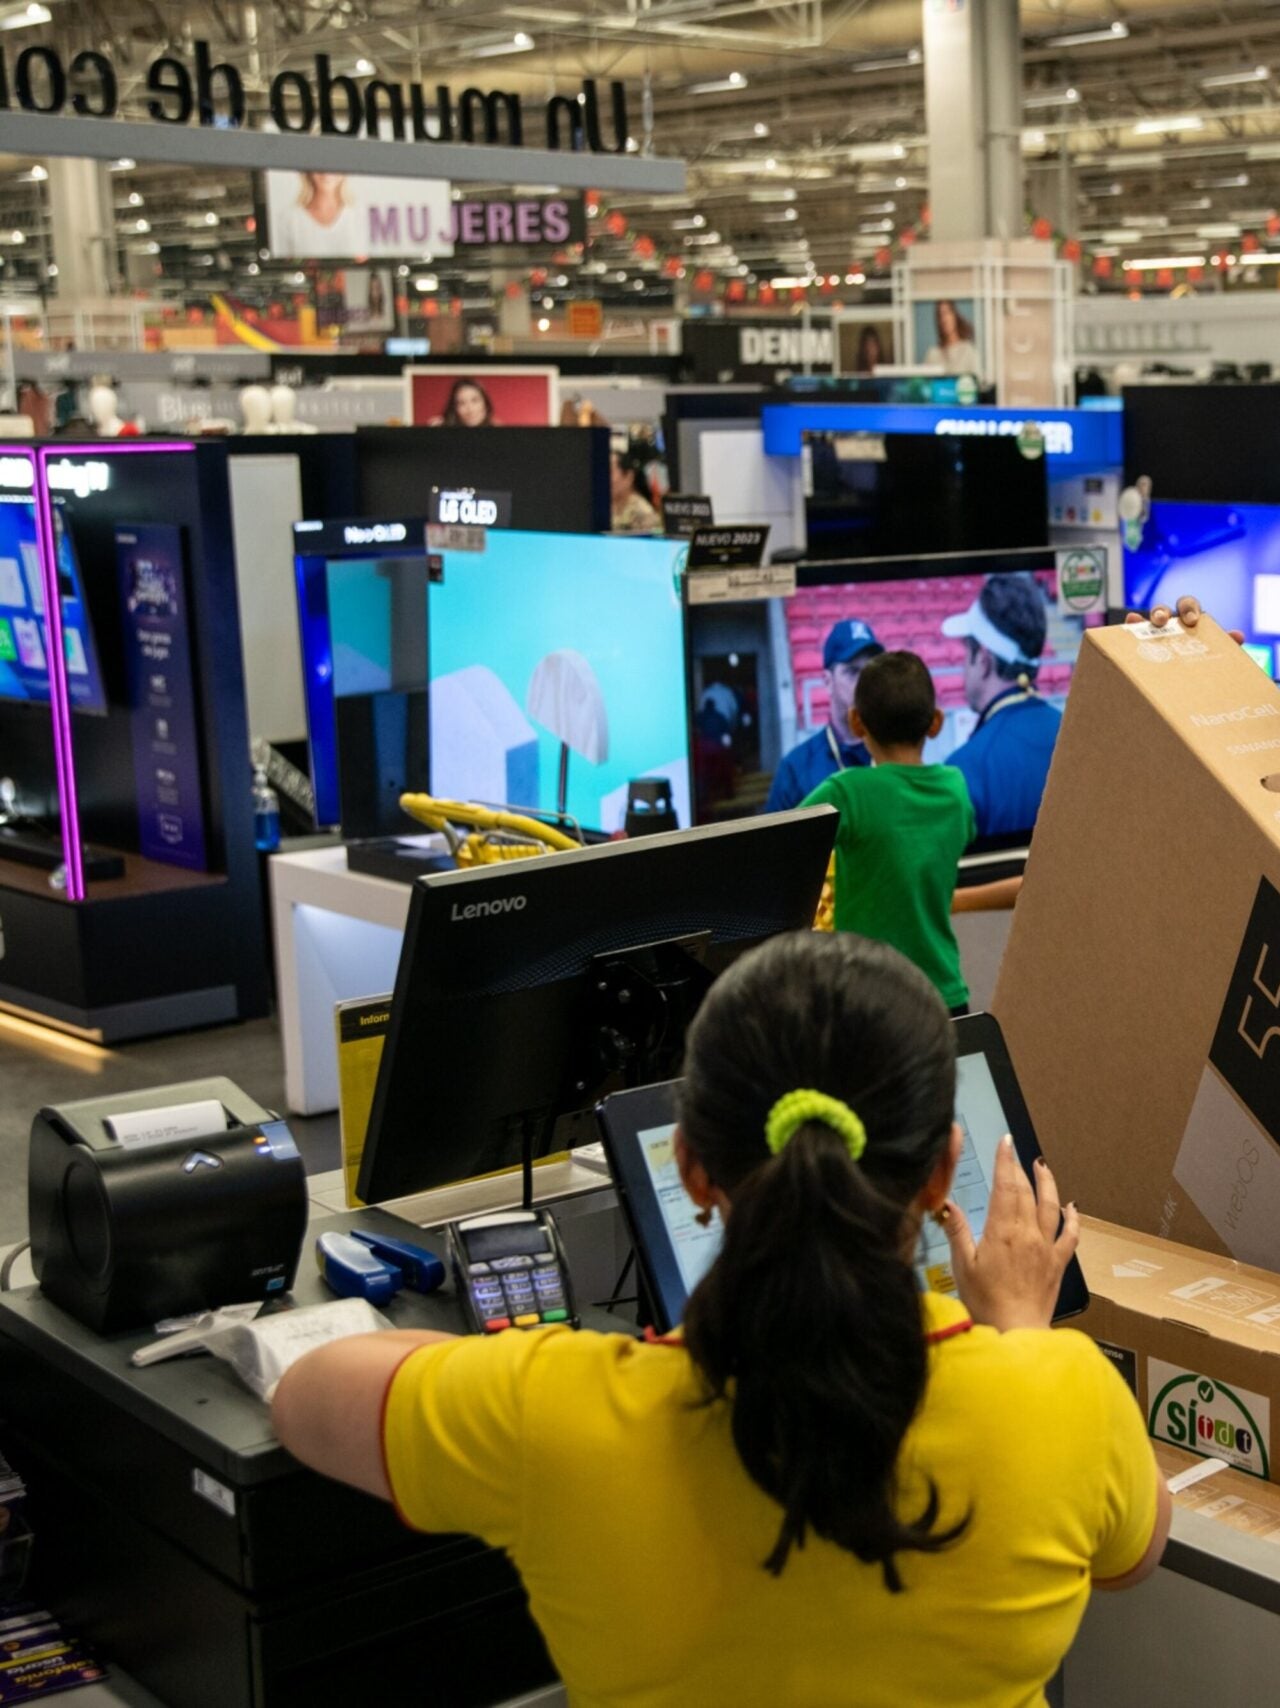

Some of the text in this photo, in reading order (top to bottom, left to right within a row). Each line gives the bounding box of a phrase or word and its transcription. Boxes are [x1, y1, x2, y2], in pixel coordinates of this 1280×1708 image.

[367, 200, 571, 246] MUJERES
[695, 531, 761, 547] NUEVO 2023
[1189, 703, 1280, 728] NanoCell
[451, 895, 527, 922] Lenovo
[1224, 1138, 1259, 1230] webOS
